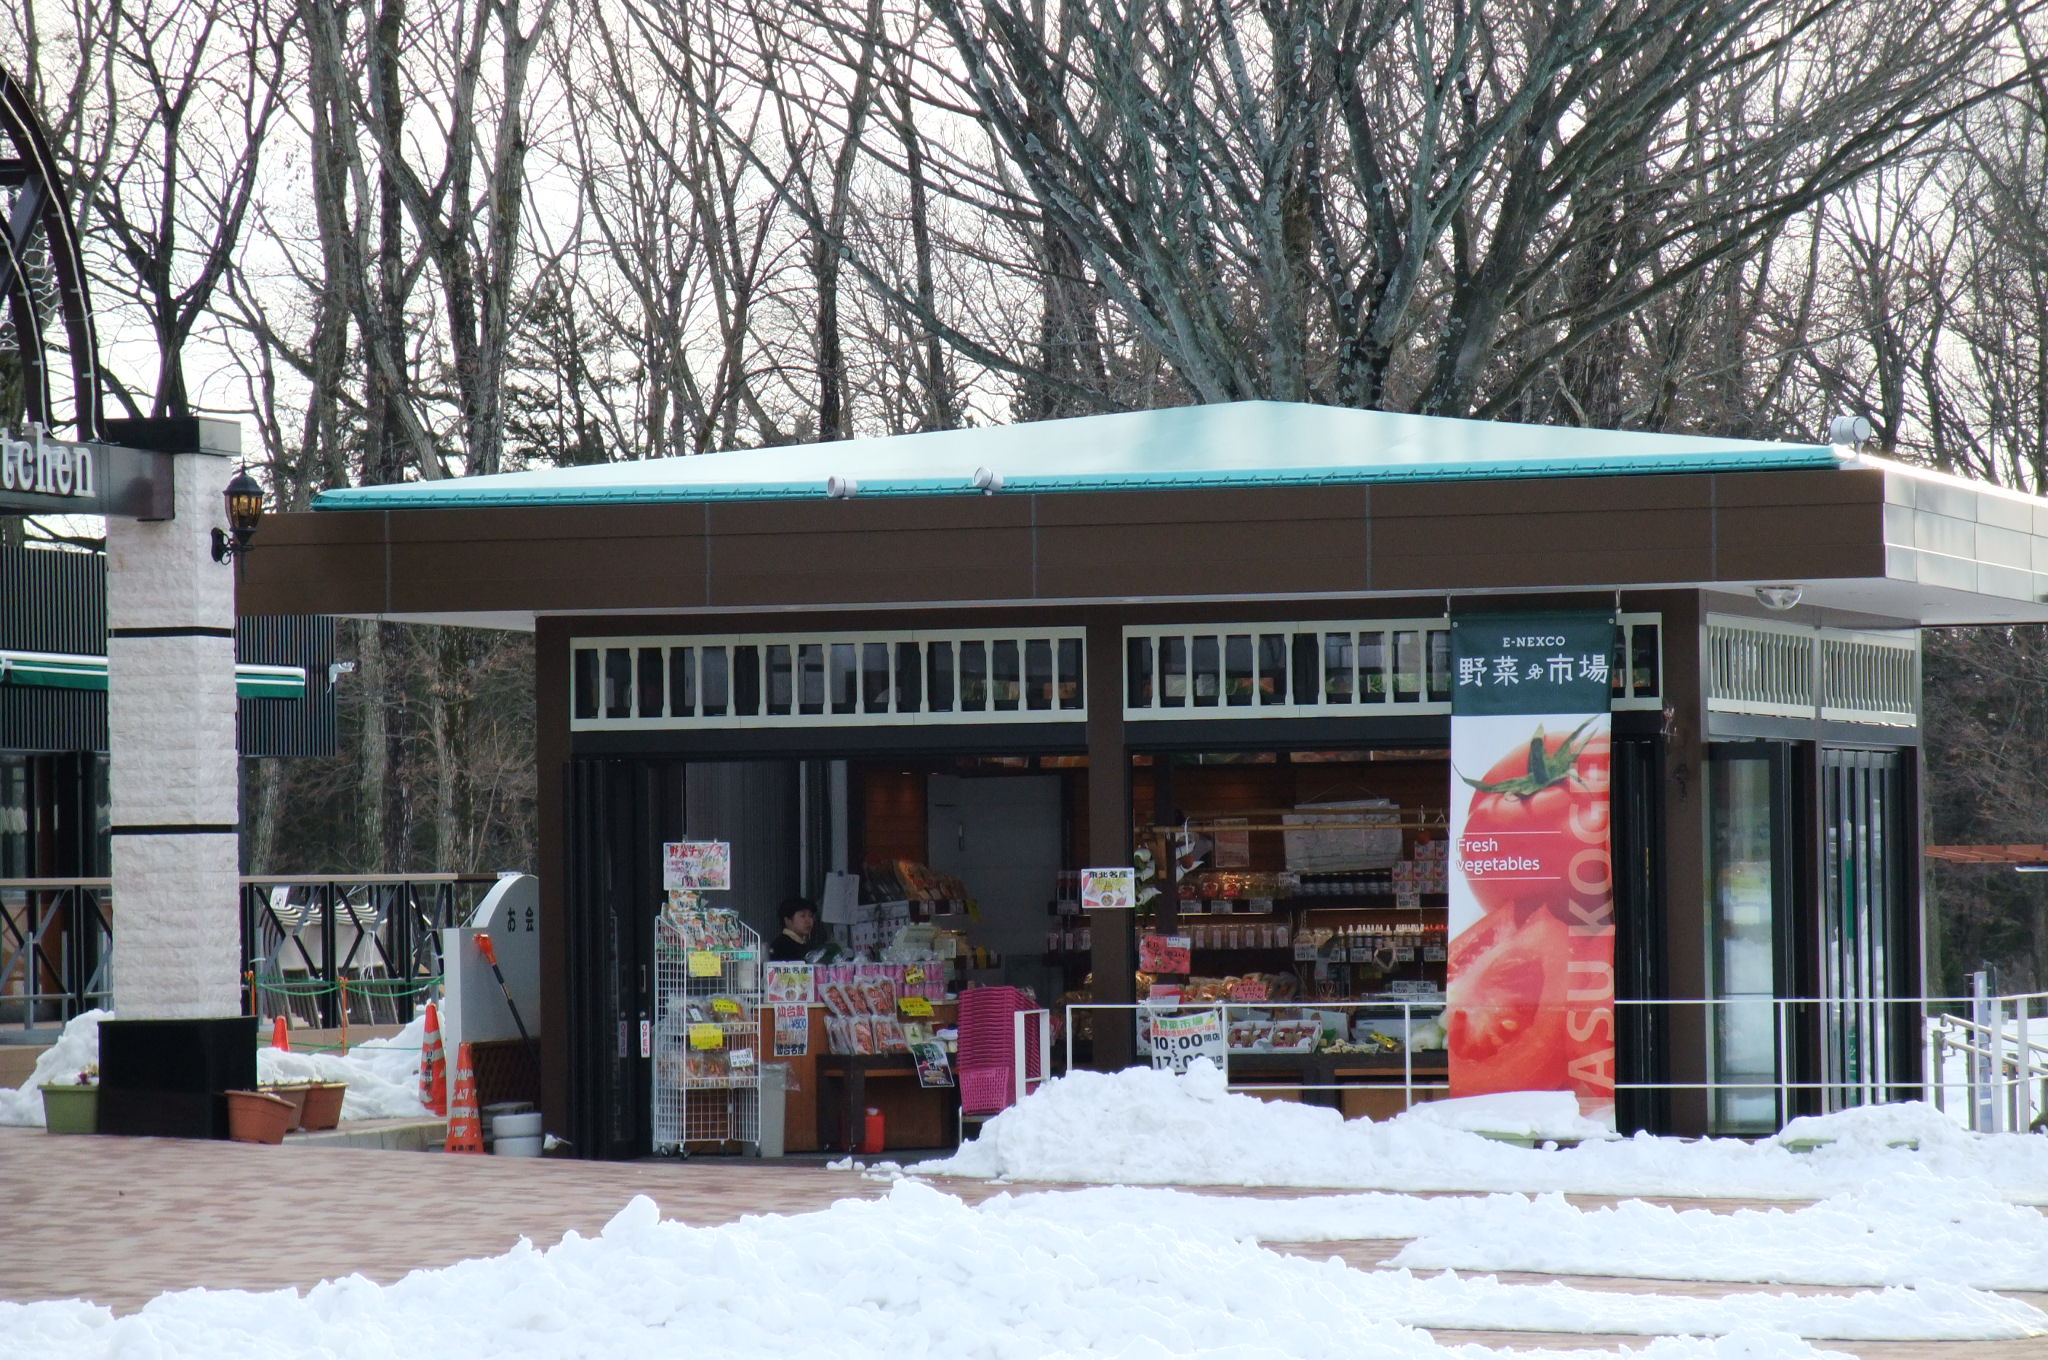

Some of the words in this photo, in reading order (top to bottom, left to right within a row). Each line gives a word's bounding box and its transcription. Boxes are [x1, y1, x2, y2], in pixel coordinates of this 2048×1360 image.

[0, 422, 96, 497] tchen
[1503, 636, 1566, 648] E-NEXCO
[1457, 837, 1498, 852] Fresh
[1456, 856, 1540, 875] vegetables
[1153, 1034, 1203, 1050] 10:00
